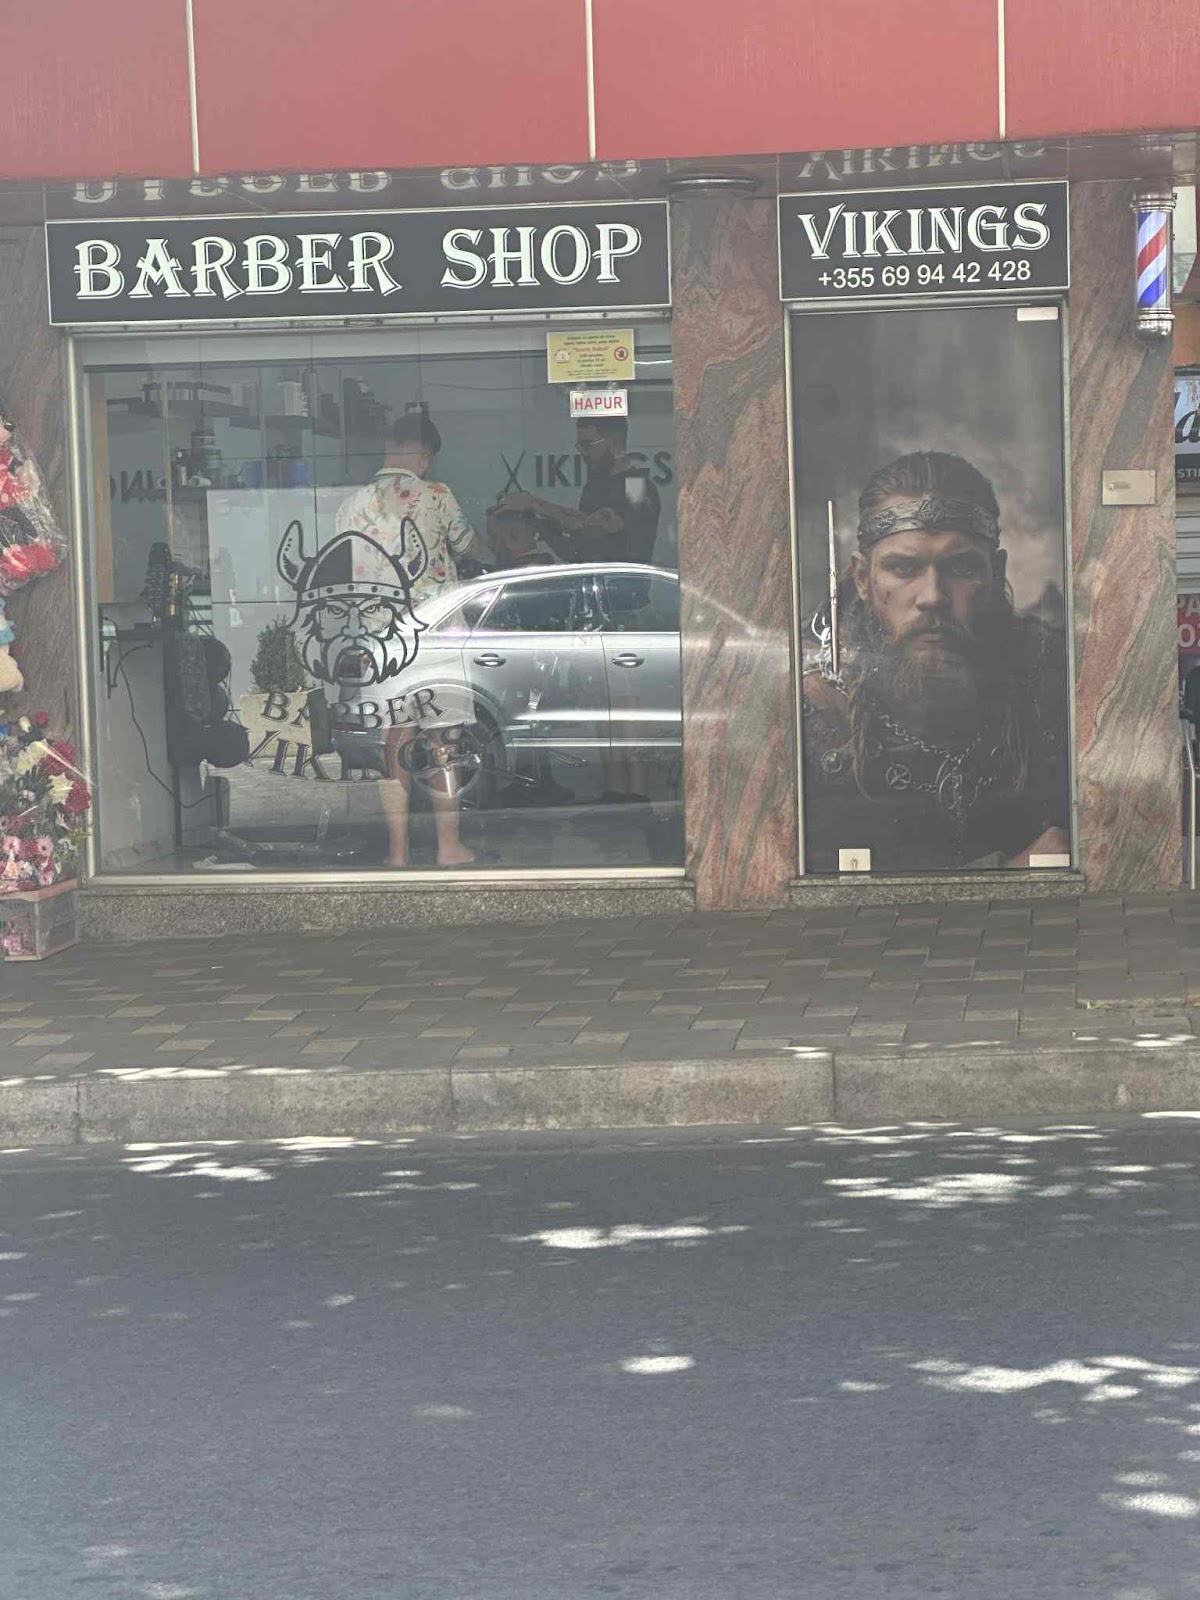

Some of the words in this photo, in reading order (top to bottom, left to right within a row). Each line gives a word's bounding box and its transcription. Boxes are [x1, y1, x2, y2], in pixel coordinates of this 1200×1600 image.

[797, 202, 1050, 259] VIKINGS
[73, 231, 402, 301] BARBER
[440, 223, 642, 289] SHOP
[819, 267, 875, 289] +355
[882, 266, 910, 286] 69
[917, 264, 945, 285] 94
[952, 262, 981, 282] 42
[988, 260, 1031, 281] 428
[574, 396, 623, 411] HAPUR
